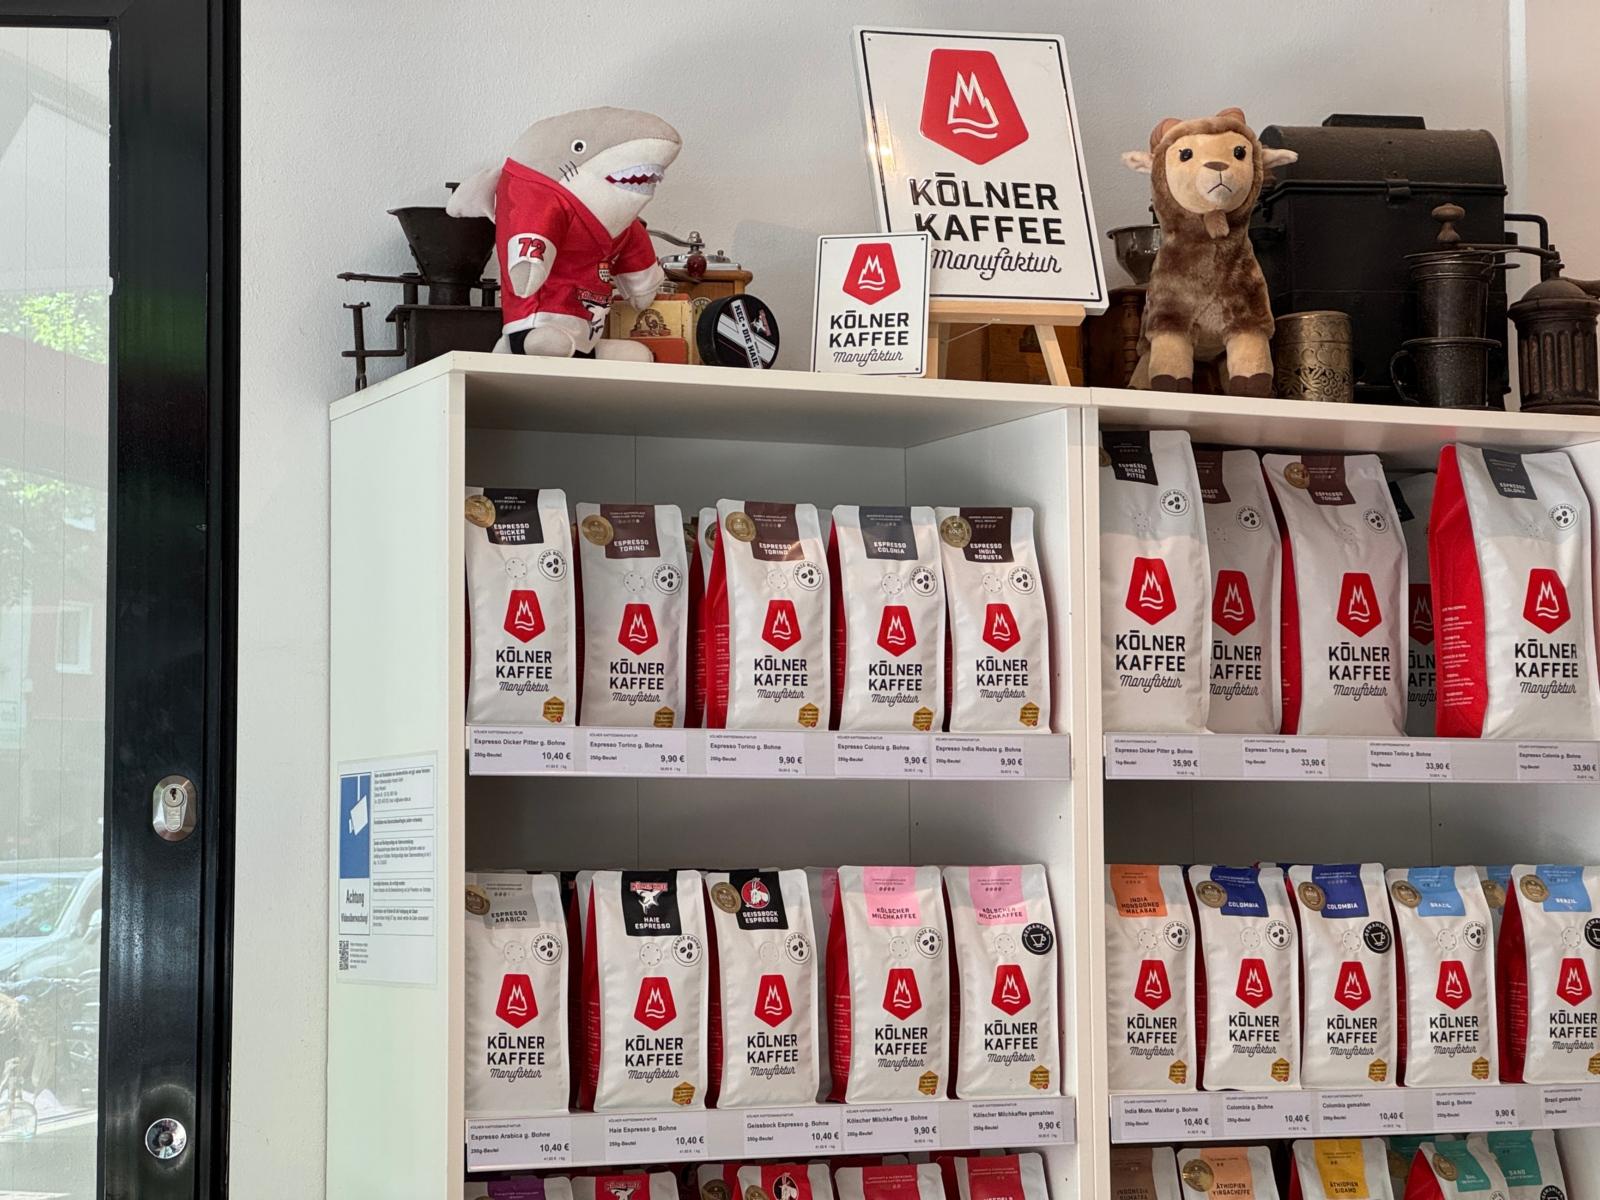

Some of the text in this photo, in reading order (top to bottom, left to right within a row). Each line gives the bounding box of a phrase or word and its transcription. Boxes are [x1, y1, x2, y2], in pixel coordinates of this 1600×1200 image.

[915, 214, 1065, 247] KAFFEE
[519, 237, 546, 261] 72
[931, 248, 1061, 280] Manufaktur
[742, 329, 752, 344] DIE
[830, 331, 908, 348] KAFFEE
[833, 349, 903, 367] Manufaktur
[1116, 655, 1185, 672] KAFFEE
[496, 666, 552, 679] KAFFEE
[1330, 665, 1390, 681] KAFFEE
[1516, 663, 1578, 678] KAFFEE
[610, 677, 664, 690] KAFFEE
[755, 674, 808, 686] KAFFEE
[869, 679, 922, 691] KAFFEE
[977, 674, 1028, 686] KAFFEE
[1120, 674, 1182, 693] Manufaktur
[499, 680, 549, 696] Manufaktur
[1334, 683, 1388, 701] Manufaktur
[1520, 680, 1576, 699] Manufaktur
[613, 691, 660, 706] Manufaktur
[757, 688, 804, 703] Manufaktur
[872, 693, 919, 707] Manufaktur
[980, 688, 1026, 702] Manufaktur
[542, 752, 563, 761] 10,40
[661, 755, 677, 764] 9,90
[779, 757, 795, 765] 9,90
[904, 757, 920, 765] 9,90
[1001, 759, 1016, 767] 9,90
[1301, 759, 1320, 767] 33,90
[1173, 760, 1191, 768] 35,90
[1573, 764, 1590, 772] 33,90
[346, 890, 364, 907] Achtung
[1128, 1032, 1177, 1043] KAFFEE
[1230, 1030, 1280, 1042] KAFFEE
[1328, 1032, 1377, 1043] KAFFEE
[1431, 1030, 1479, 1042] KAFFEE
[1550, 1027, 1597, 1038] KAFFEE
[875, 1042, 927, 1055] KAFFEE
[985, 1037, 1038, 1050] KAFFEE
[1233, 1043, 1276, 1057] Manufaktur
[1552, 1040, 1594, 1053] Manufaktur
[748, 1049, 798, 1063] KAFFEE
[1130, 1046, 1174, 1060] Manufaktur
[1330, 1045, 1374, 1059] Manufaktur
[1434, 1044, 1477, 1058] Manufaktur
[488, 1052, 545, 1065] KAFFEE
[626, 1053, 683, 1066] KAFFEE
[878, 1057, 925, 1072] Manufaktur
[988, 1051, 1035, 1066] Manufaktur
[490, 1067, 542, 1083] Manufaktur
[628, 1068, 679, 1083] Manufaktur
[751, 1064, 795, 1080] Manufaktur
[1285, 1115, 1303, 1123] 10,40
[1380, 1112, 1398, 1121] 10,40
[1496, 1109, 1509, 1118] 9,90
[1039, 1121, 1061, 1130] 9,90 €
[1184, 1118, 1202, 1126] 10,40
[811, 1132, 839, 1141] 10,40 €
[914, 1126, 937, 1135] 9,90 €
[540, 1143, 569, 1152] 10,40 €
[676, 1136, 704, 1146] 10,40 €
